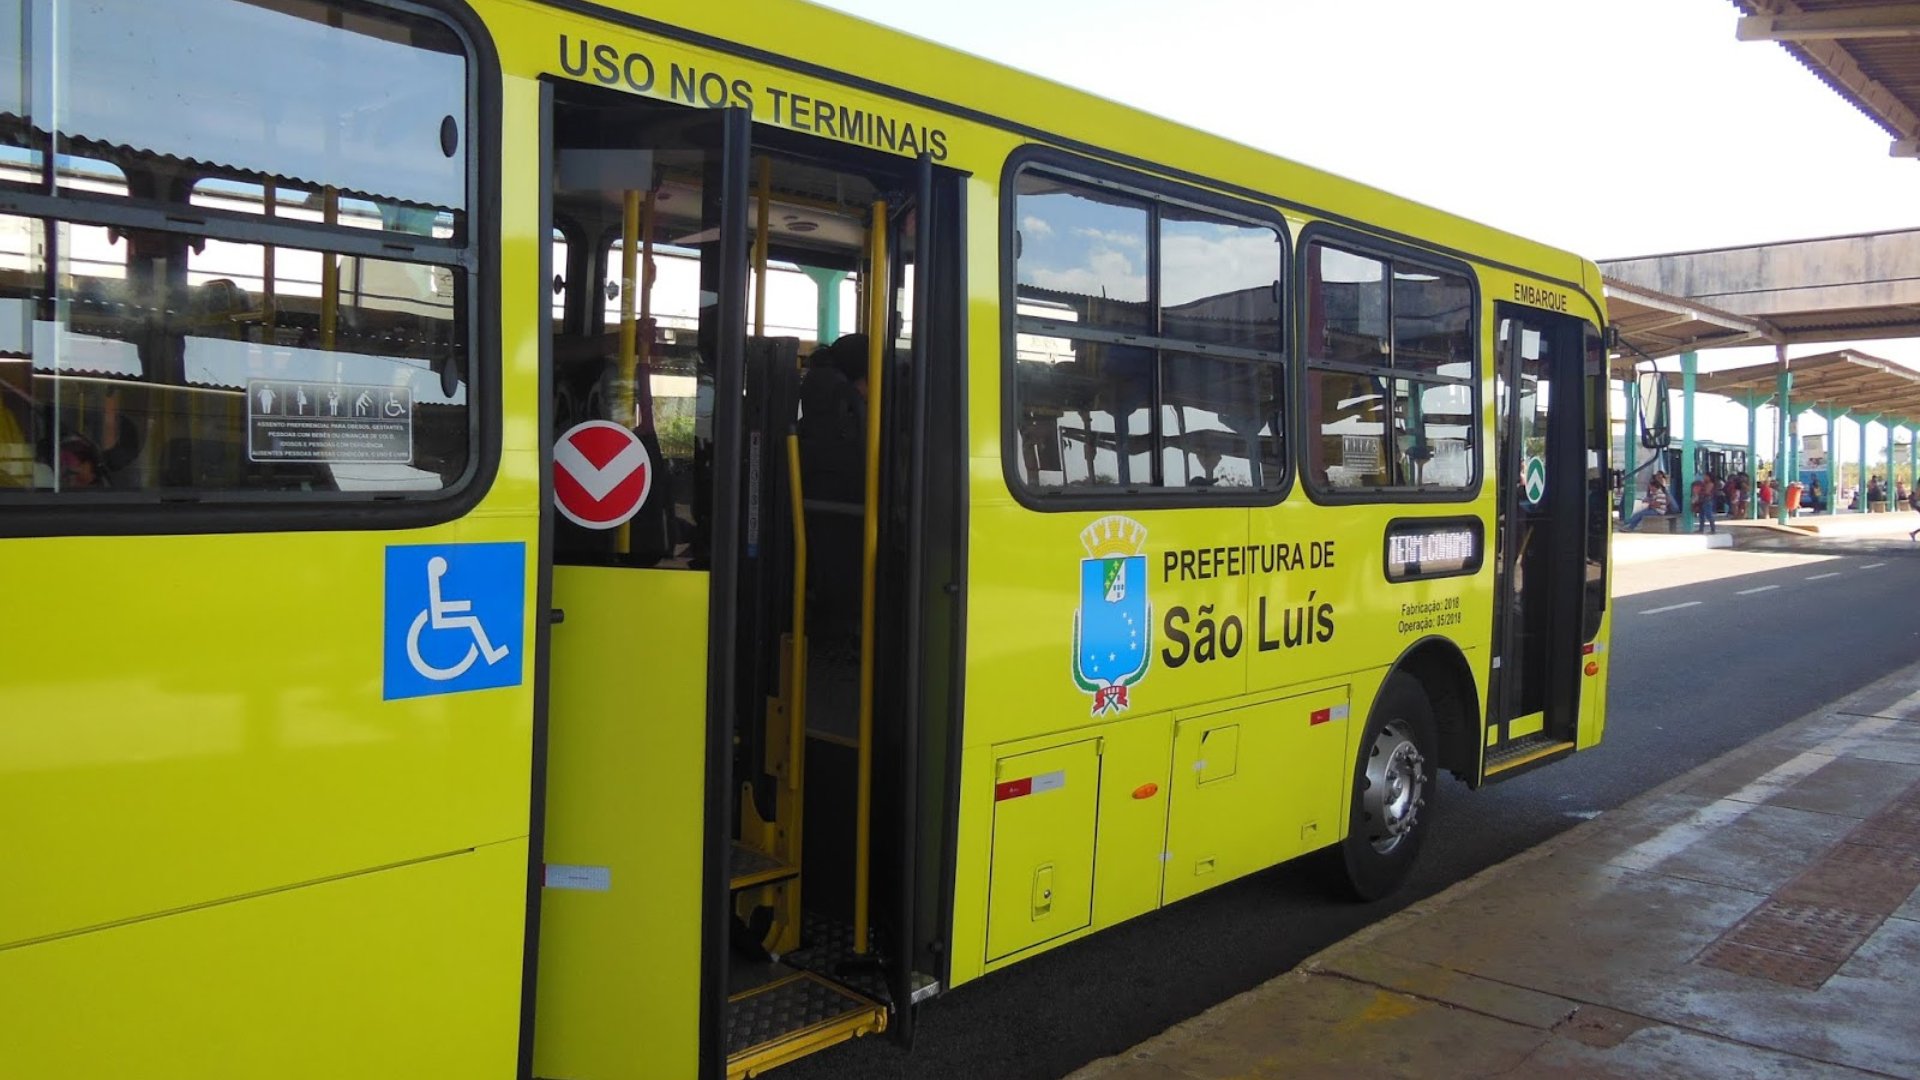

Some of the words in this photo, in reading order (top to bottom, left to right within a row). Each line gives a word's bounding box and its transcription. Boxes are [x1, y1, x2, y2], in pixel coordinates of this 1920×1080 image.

[560, 34, 654, 92] USO
[670, 63, 753, 116] NOS
[766, 87, 948, 161] TERMINAIS
[1514, 283, 1567, 312] EMBARQUE
[1164, 543, 1305, 583] PREFEITURA
[1310, 541, 1335, 569] DE
[1401, 600, 1443, 616] Fabricação:
[1444, 596, 1460, 610] 2018
[1162, 604, 1243, 668] São
[1258, 590, 1334, 652] Luís
[1398, 616, 1435, 635] Operação:
